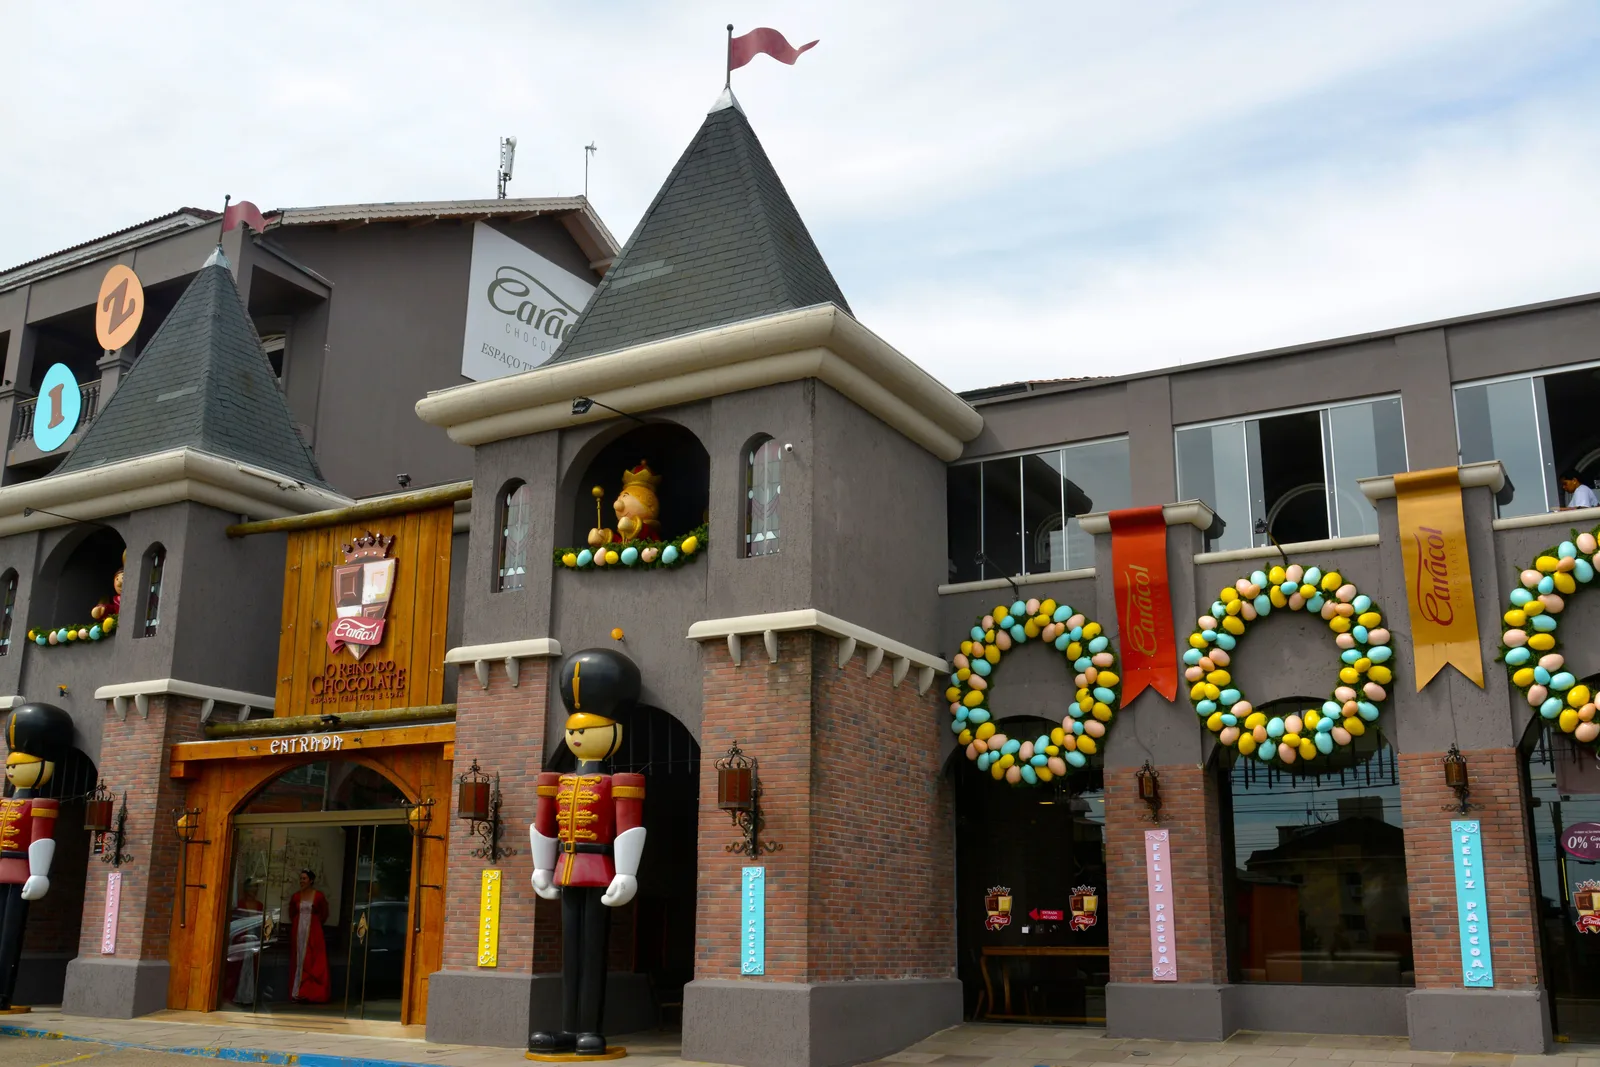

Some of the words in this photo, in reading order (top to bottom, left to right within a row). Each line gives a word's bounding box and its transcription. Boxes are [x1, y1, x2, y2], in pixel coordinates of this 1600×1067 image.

[103, 278, 136, 335] 2
[481, 342, 520, 369] ESPAÇO
[48, 383, 65, 430] 1
[1412, 526, 1454, 627] Caracol
[335, 618, 380, 641] Caracol
[1124, 564, 1157, 656] Caracol
[310, 668, 406, 696] CHOCOLATE
[326, 663, 337, 678] O
[339, 662, 375, 678] REINO
[377, 660, 396, 673] DO
[270, 735, 343, 754] ENTRADA
[1461, 835, 1476, 889] FELIZ
[1567, 836, 1588, 849] 0%
[1152, 843, 1164, 892] FELIZ
[748, 876, 756, 912] FELIZ
[1155, 903, 1170, 964] PÁSCOA
[1466, 902, 1484, 968] PÁSCOA
